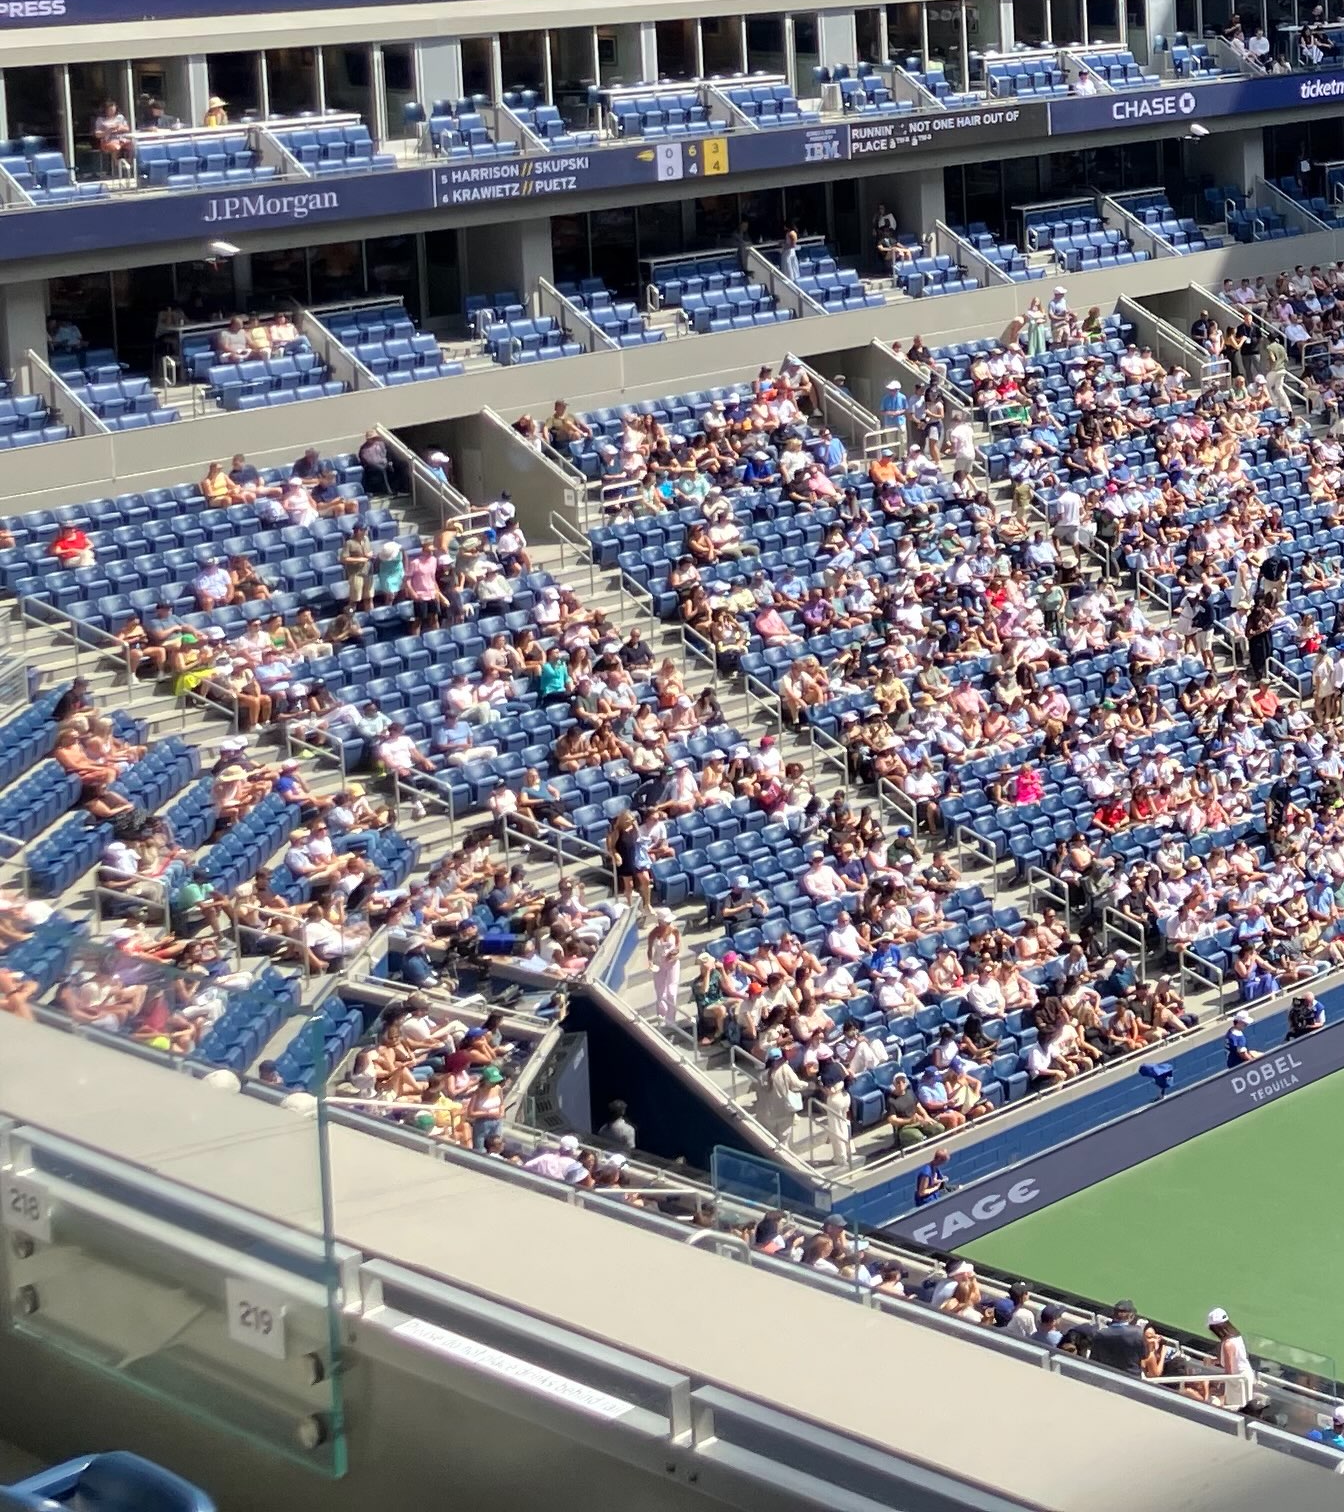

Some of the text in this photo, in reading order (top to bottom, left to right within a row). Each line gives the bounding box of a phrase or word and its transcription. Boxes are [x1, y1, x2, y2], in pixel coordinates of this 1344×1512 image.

[1112, 97, 1176, 120] CHASE
[909, 120, 931, 133] NOT
[933, 117, 956, 131] ONE
[957, 114, 981, 129] HAIR
[983, 112, 1004, 126] OUT
[1005, 110, 1020, 123] OF
[665, 142, 719, 159] 0 6 3
[805, 141, 841, 161] IBM
[852, 139, 888, 153] PLACE
[451, 164, 519, 183] HARRISON
[535, 157, 589, 173] SKUPSKI
[666, 160, 720, 177] 0 4 4
[453, 184, 520, 203] KRAWIETZ
[535, 178, 576, 193] PUETZ
[203, 189, 339, 223] J.P.Morgan
[1231, 1053, 1303, 1093] DOBEL
[1251, 1073, 1299, 1102] TEQUILA
[913, 1178, 1041, 1245] FAGE
[239, 1300, 274, 1336] 219
